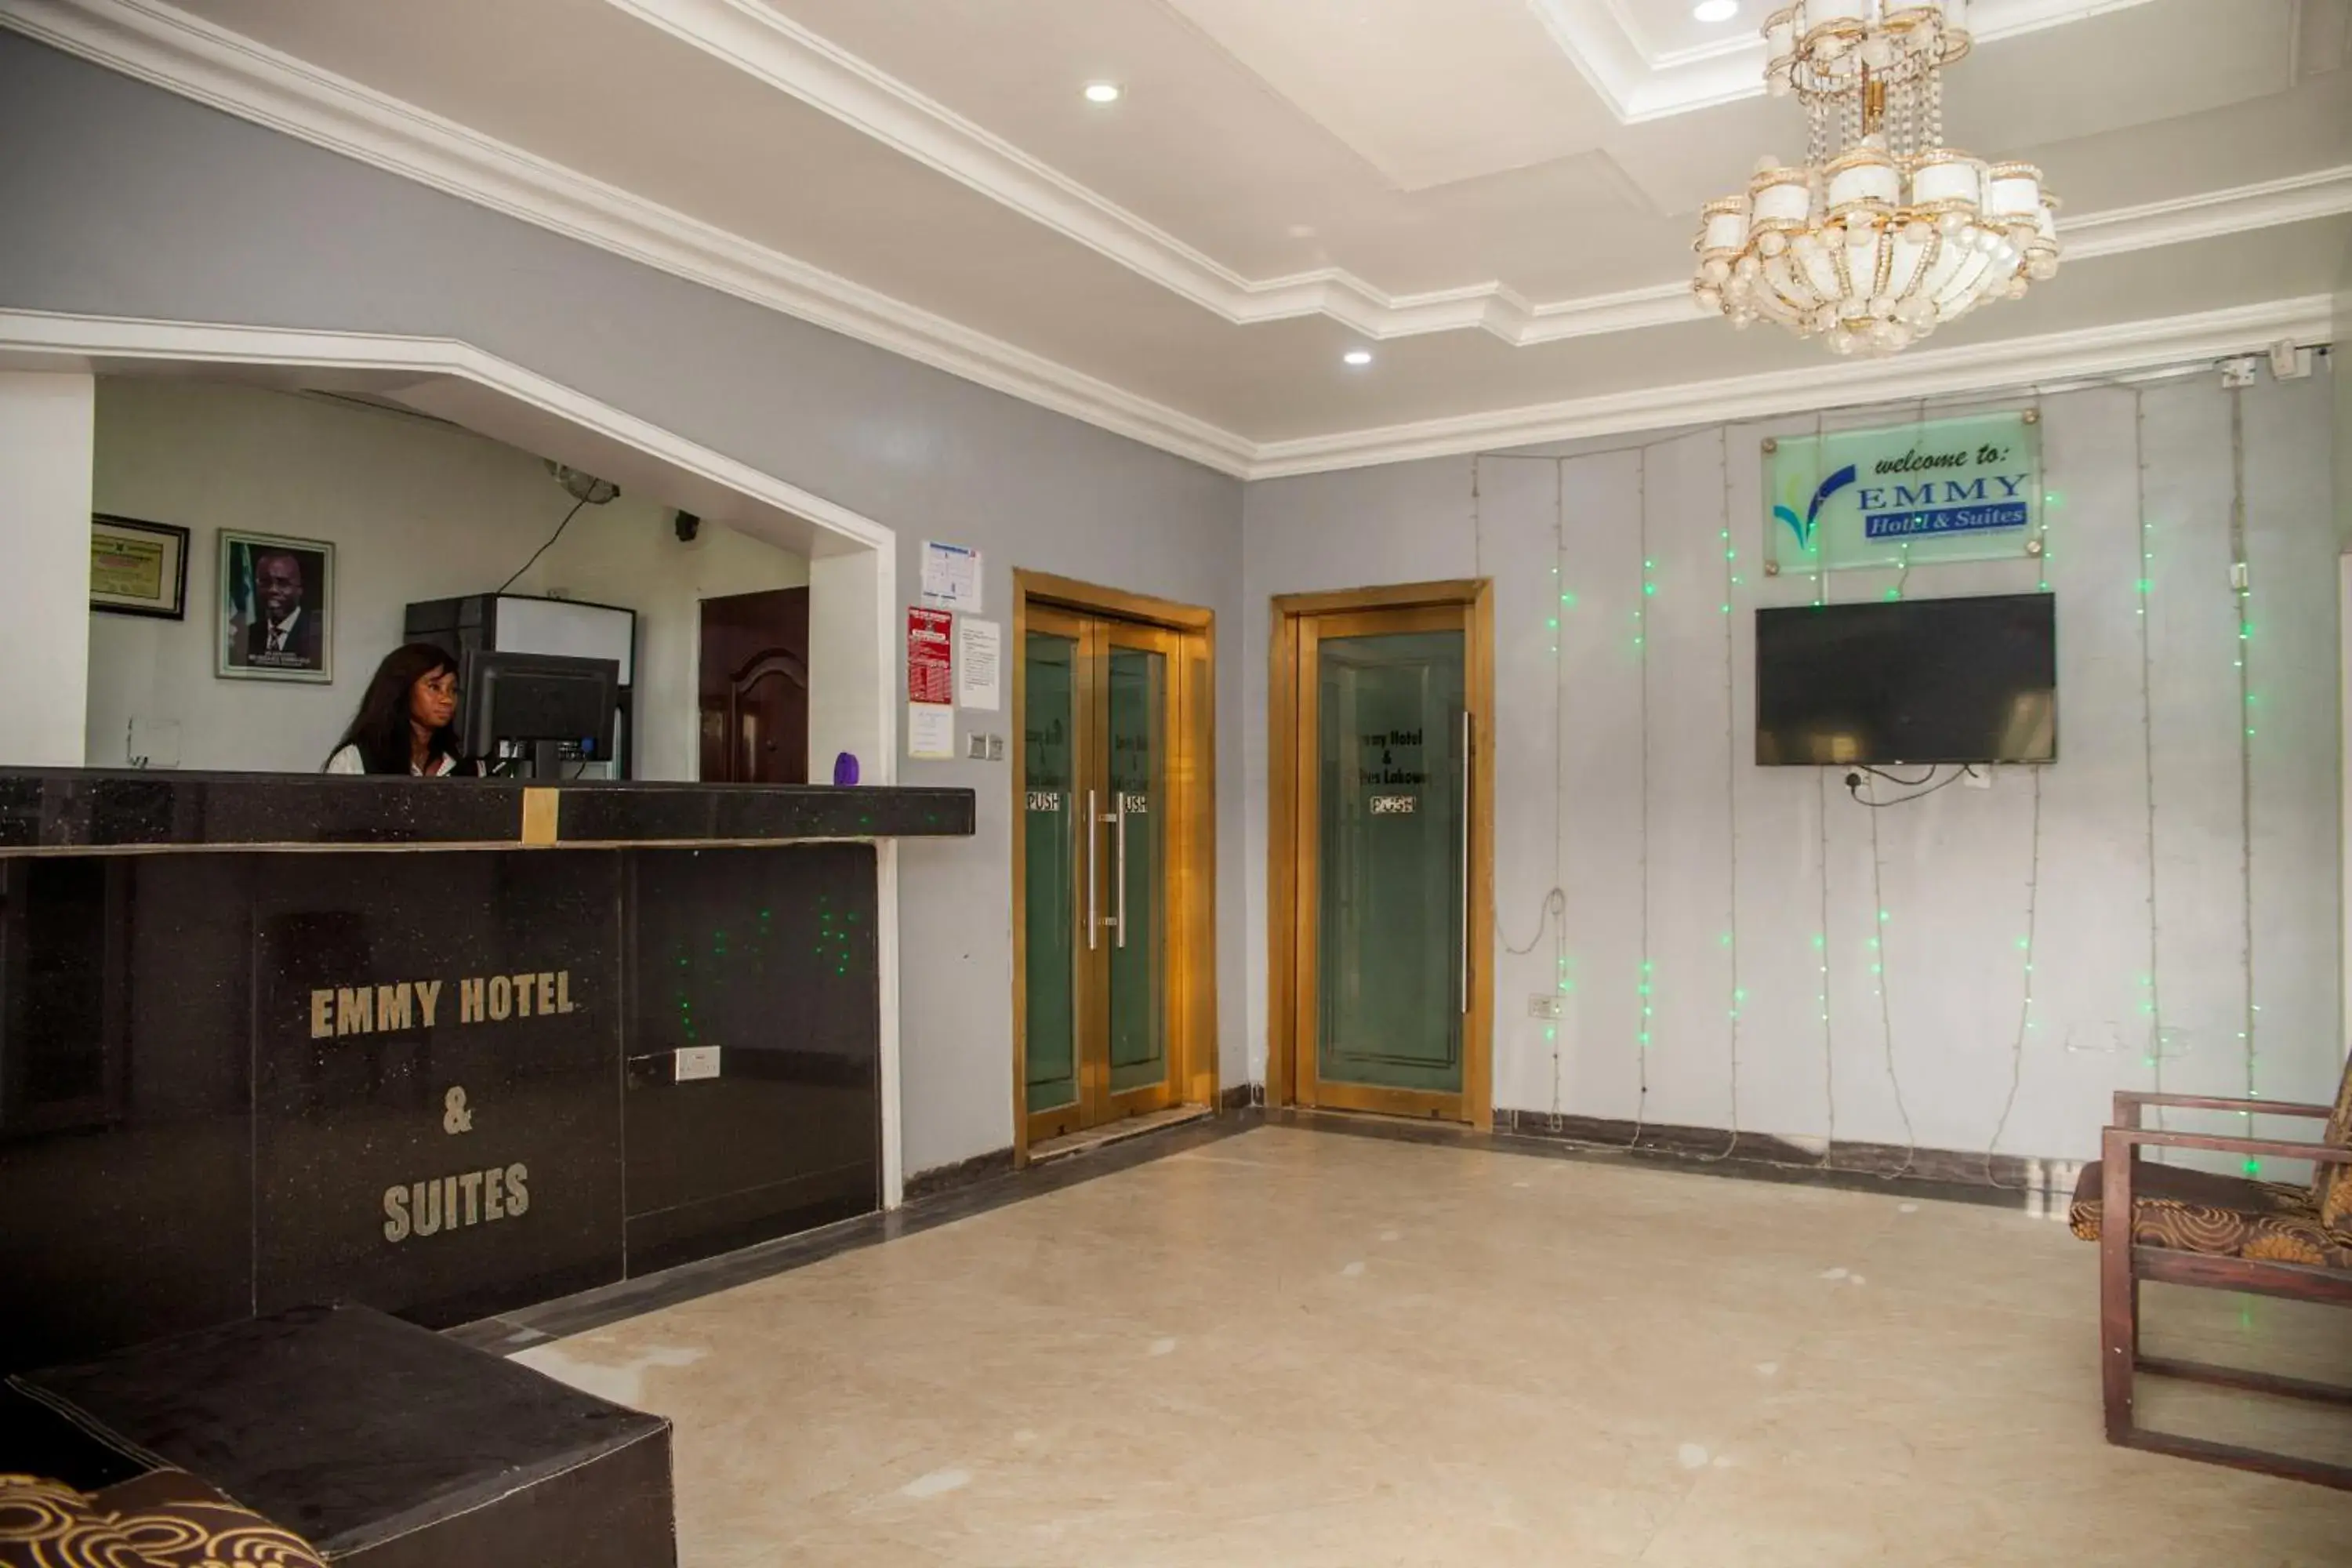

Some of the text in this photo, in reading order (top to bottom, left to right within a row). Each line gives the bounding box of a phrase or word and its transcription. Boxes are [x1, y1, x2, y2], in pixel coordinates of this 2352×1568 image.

[1875, 443, 2011, 474] welcome to:
[1857, 473, 2032, 511] EMMY
[1871, 506, 2024, 535] Hotel & Suites
[1027, 793, 1060, 810] PUSH
[1123, 796, 1148, 811] USH
[311, 969, 574, 1039] EMMY HOTEL
[443, 1085, 473, 1135] &
[383, 1162, 529, 1243] SUITES
